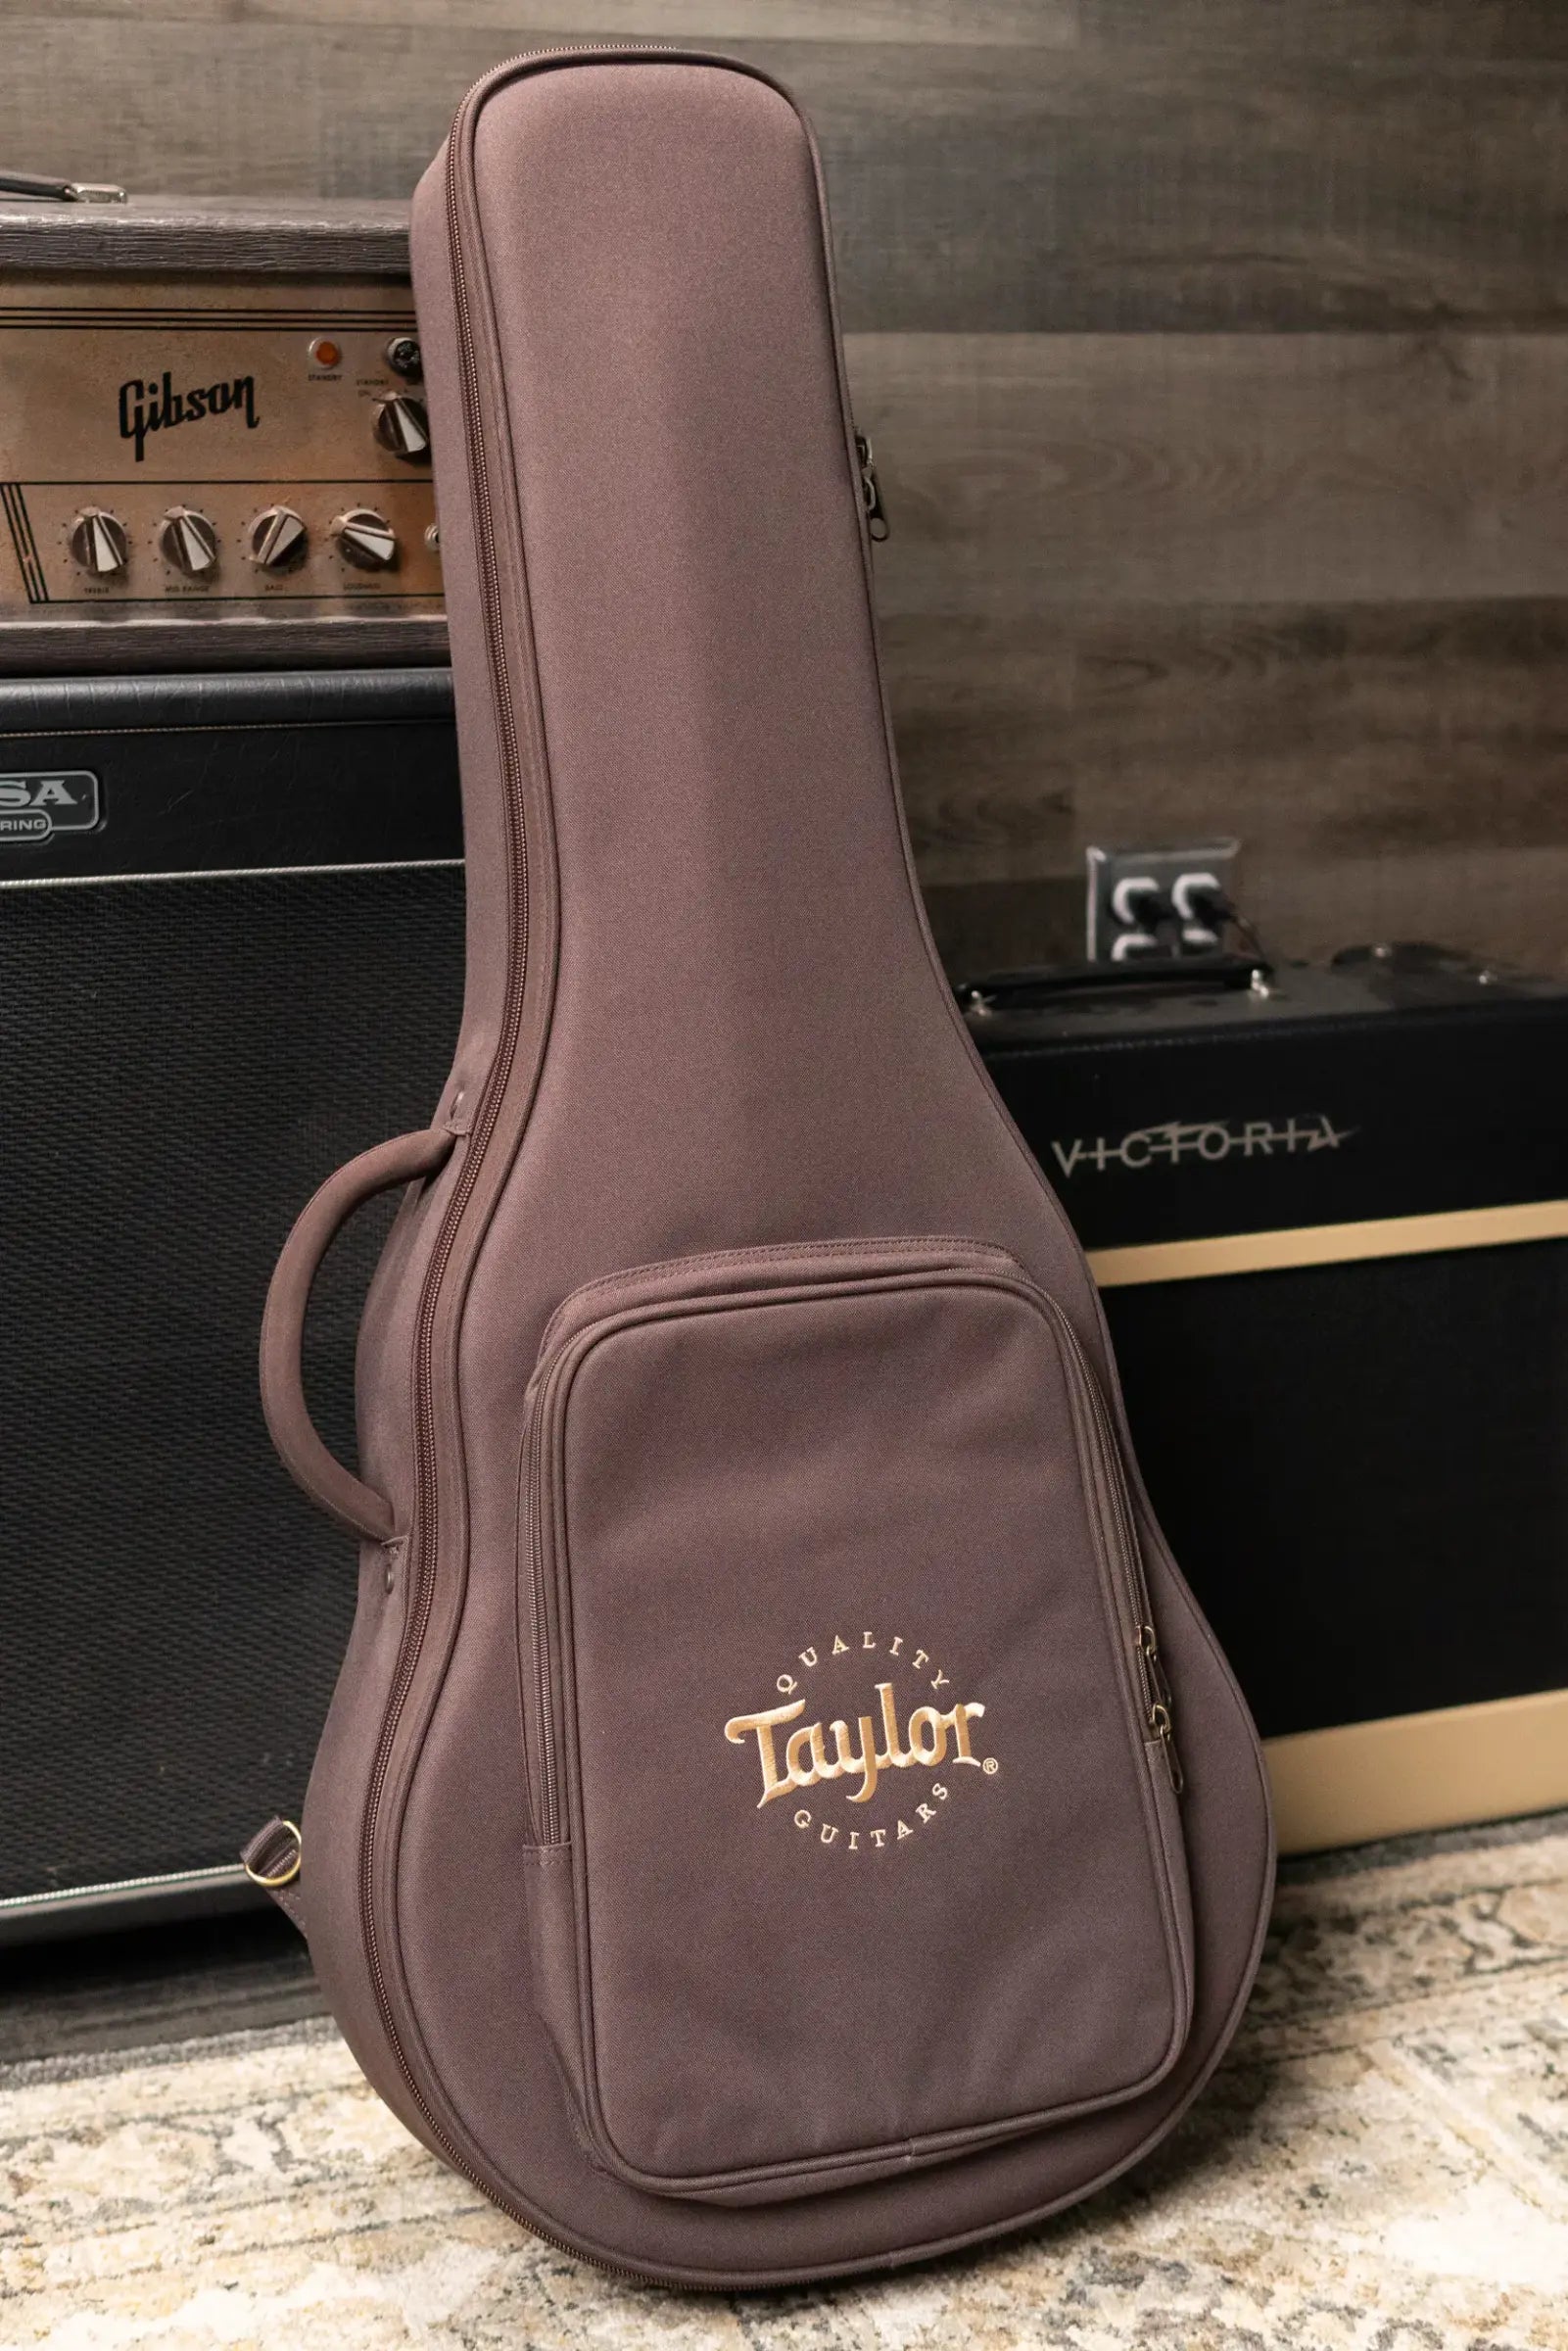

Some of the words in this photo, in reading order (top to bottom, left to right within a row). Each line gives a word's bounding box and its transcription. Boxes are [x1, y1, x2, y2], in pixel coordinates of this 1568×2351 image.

[119, 371, 261, 462] Gibson
[0, 819, 47, 831] RING
[1052, 1115, 1344, 1177] VICTORIA
[777, 1631, 950, 1695] QUALITY
[794, 1783, 948, 1849] GUITARS
